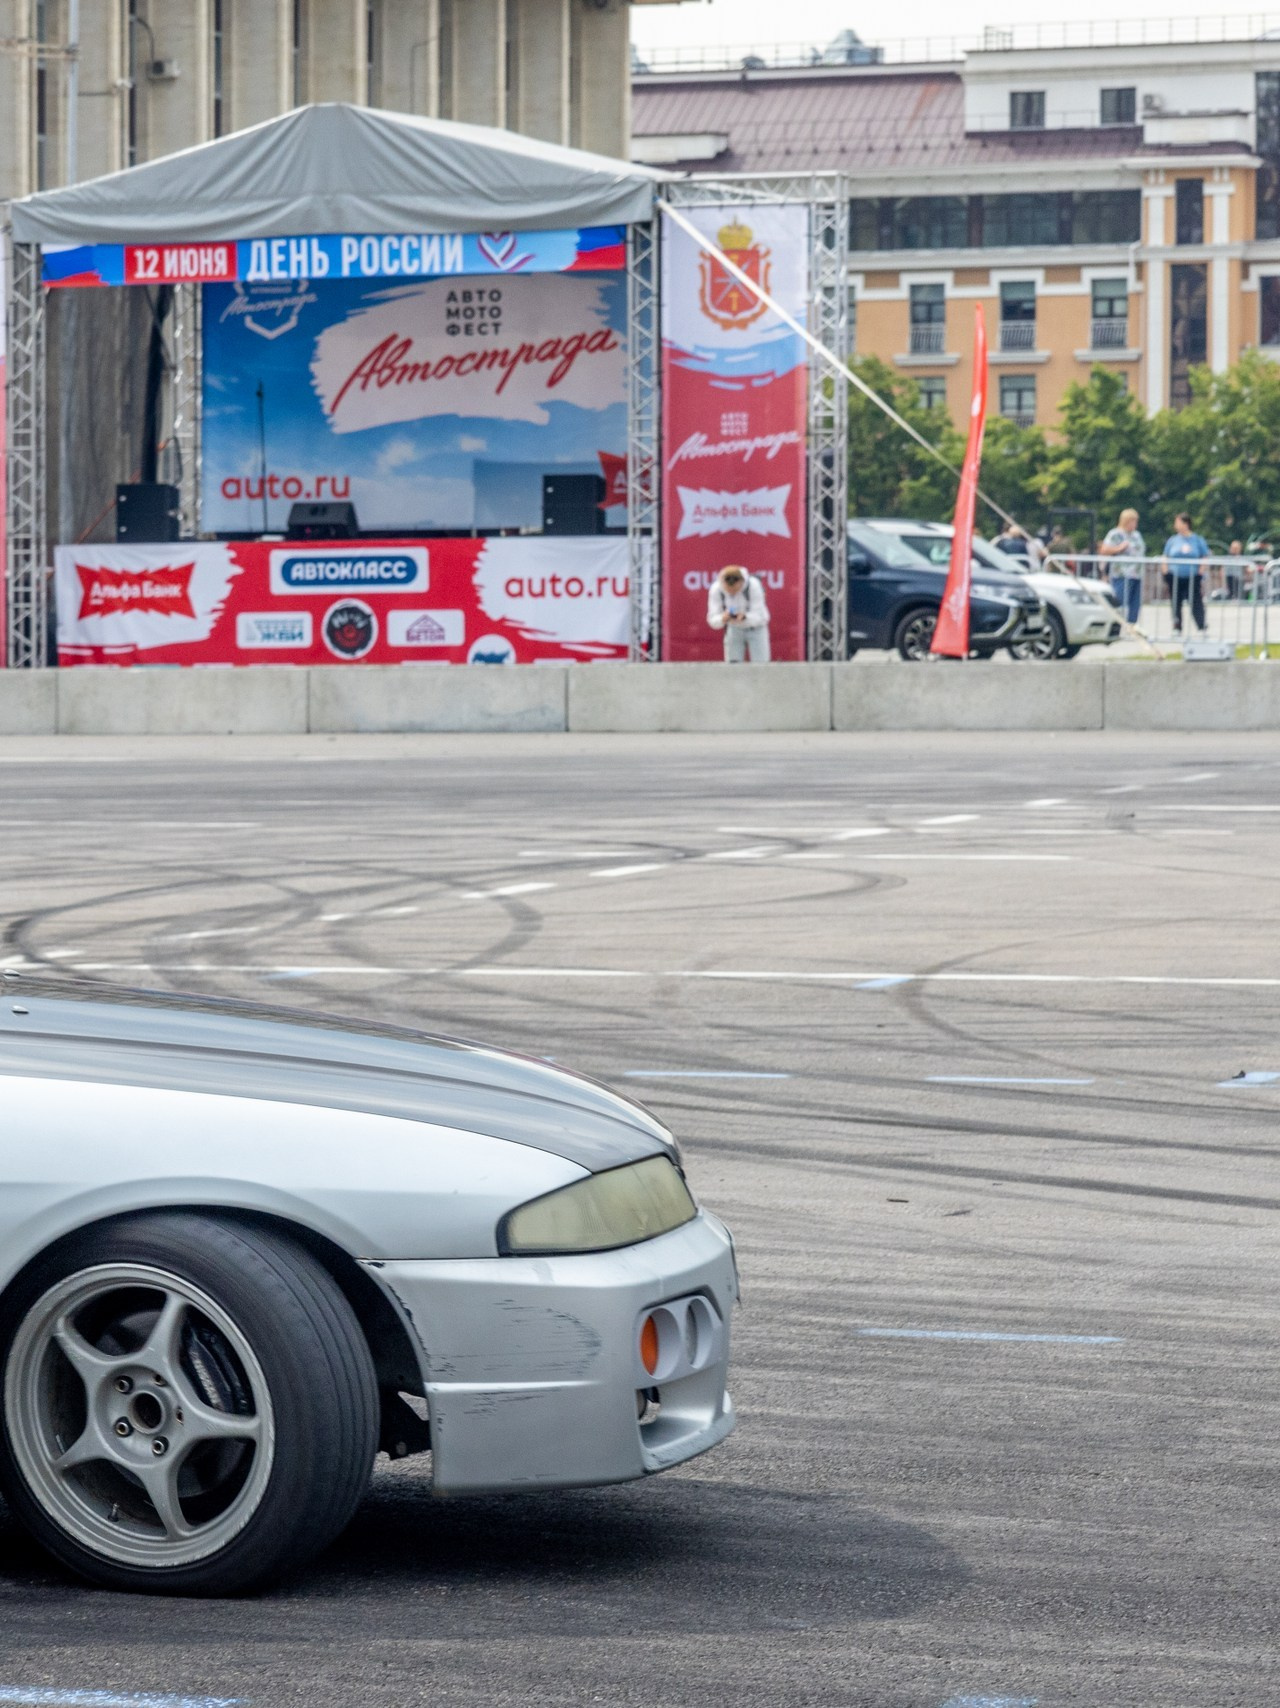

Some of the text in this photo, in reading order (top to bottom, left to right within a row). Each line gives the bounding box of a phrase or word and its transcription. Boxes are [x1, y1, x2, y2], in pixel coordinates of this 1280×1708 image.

[134, 247, 228, 279] 12 ИЮНЯ
[246, 235, 464, 281] ДЕНЬ РОССИИ
[445, 290, 503, 304] АВТО
[445, 306, 503, 320] МОТО
[445, 322, 503, 337] ФЕСТ
[330, 328, 619, 414] Автострада
[221, 474, 350, 500] auto.ru
[692, 503, 776, 519] Альфа Банк
[290, 560, 408, 581] АВТОКЛАСС
[90, 580, 183, 602] Альфа Банк
[504, 573, 630, 598] auto.ru
